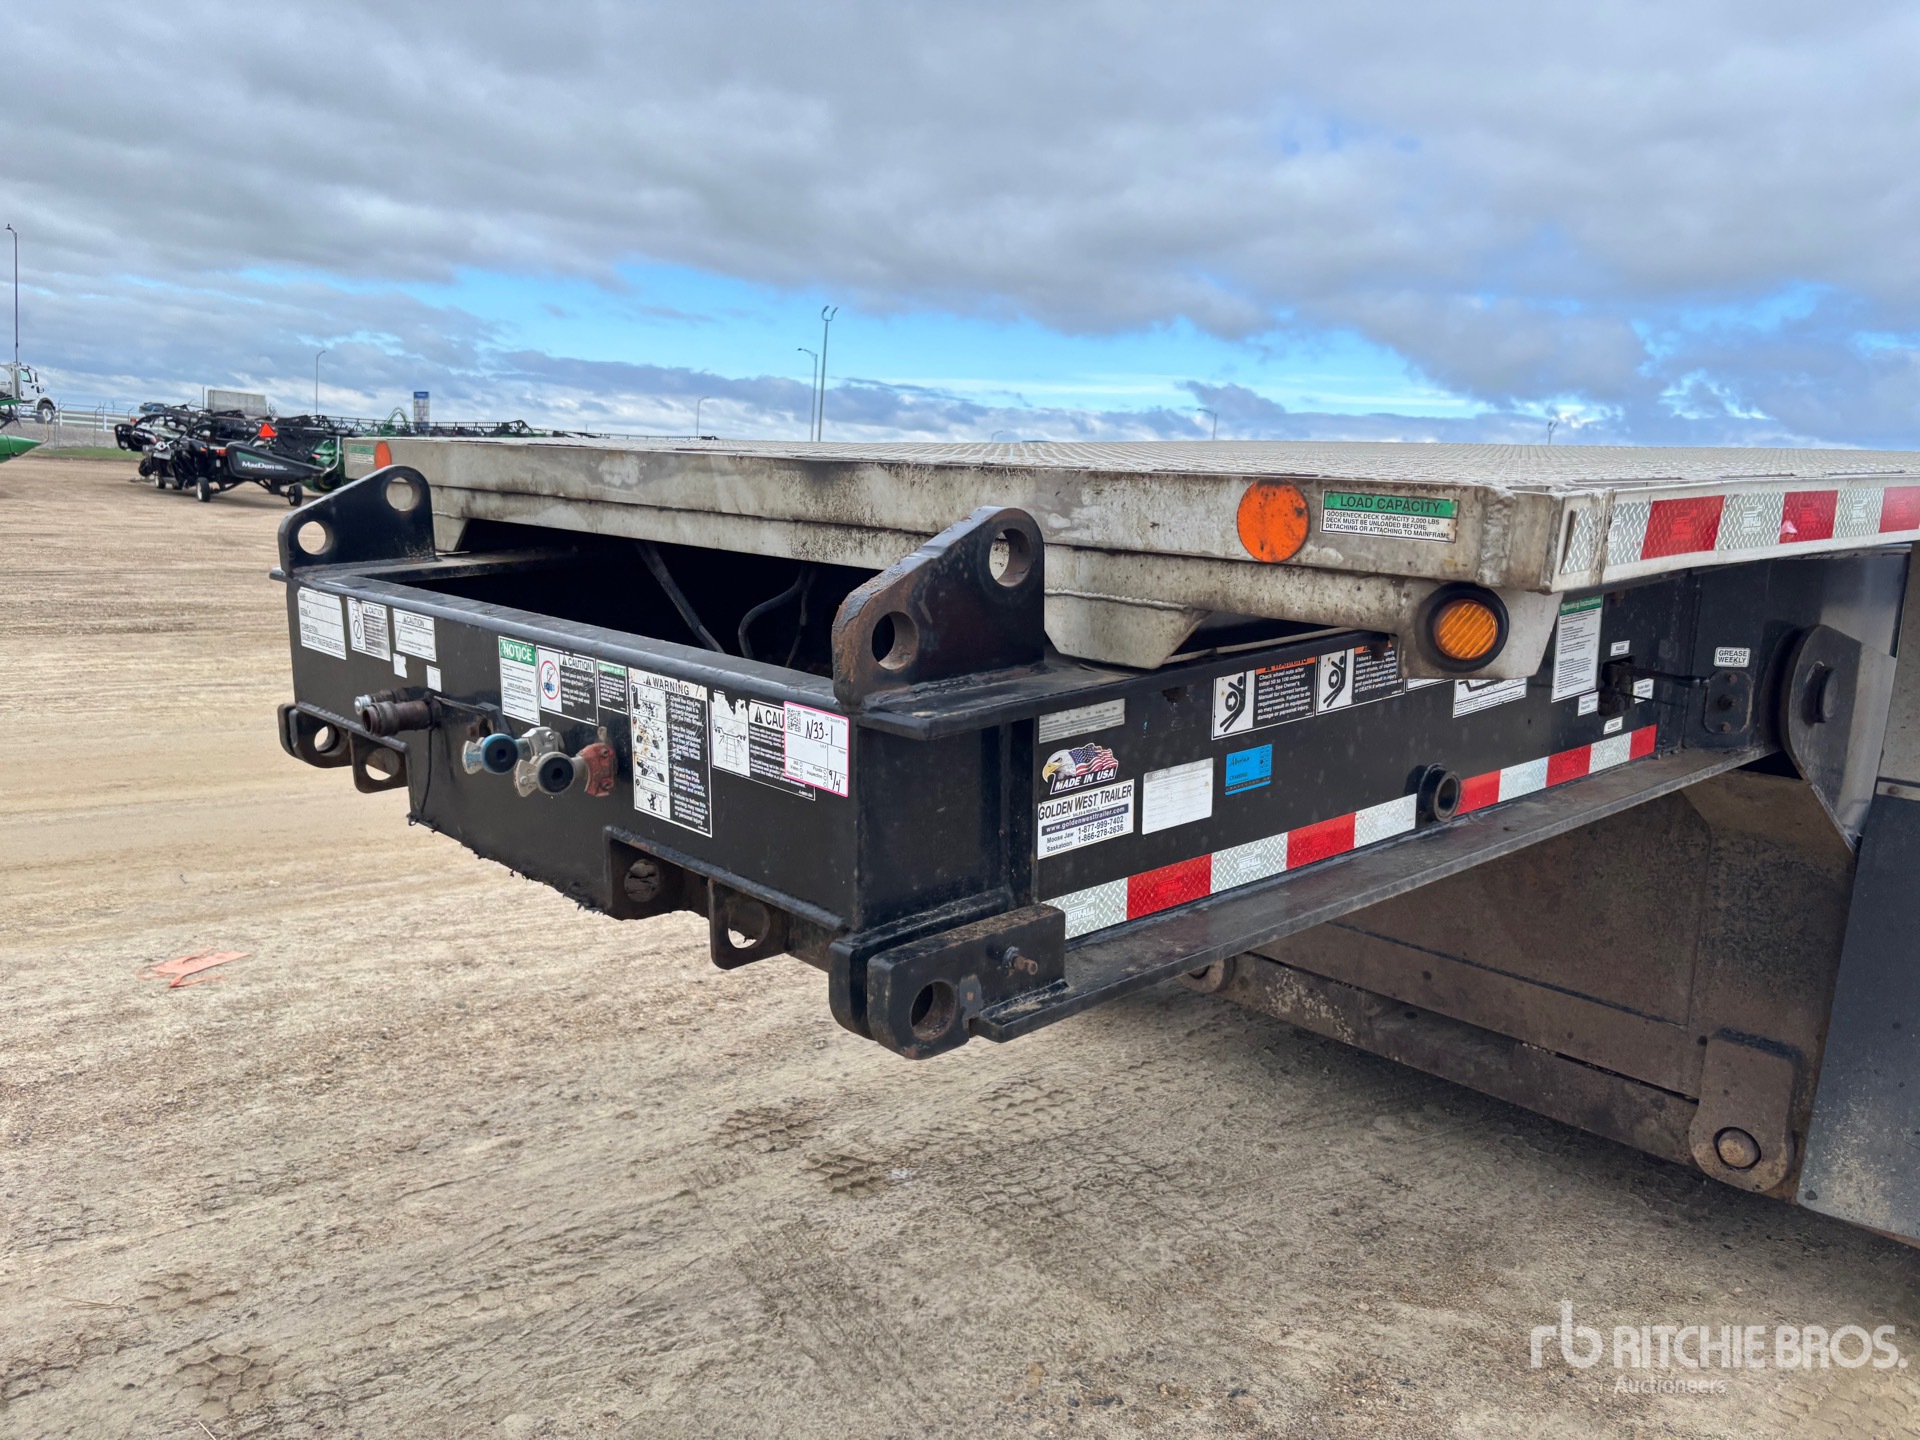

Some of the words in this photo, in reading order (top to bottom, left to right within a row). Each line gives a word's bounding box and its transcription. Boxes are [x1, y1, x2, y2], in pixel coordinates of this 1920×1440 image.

[1340, 496, 1373, 508] LOAD
[1377, 498, 1441, 513] CAPACITY
[503, 642, 532, 661] NOTICE
[568, 658, 591, 671] CAUTION
[652, 677, 689, 695] WARNING
[1055, 776, 1081, 791] MADE
[1084, 773, 1094, 783] IN
[1097, 768, 1114, 780] USA
[1039, 800, 1073, 820] GOLDEN
[1075, 794, 1098, 811] WEST
[1100, 785, 1132, 804] TRAILER
[1046, 807, 1125, 832] www.goldenwesttrailer.com
[1078, 816, 1123, 834] 1-877-999-7402
[1047, 842, 1072, 852] Saskatoon
